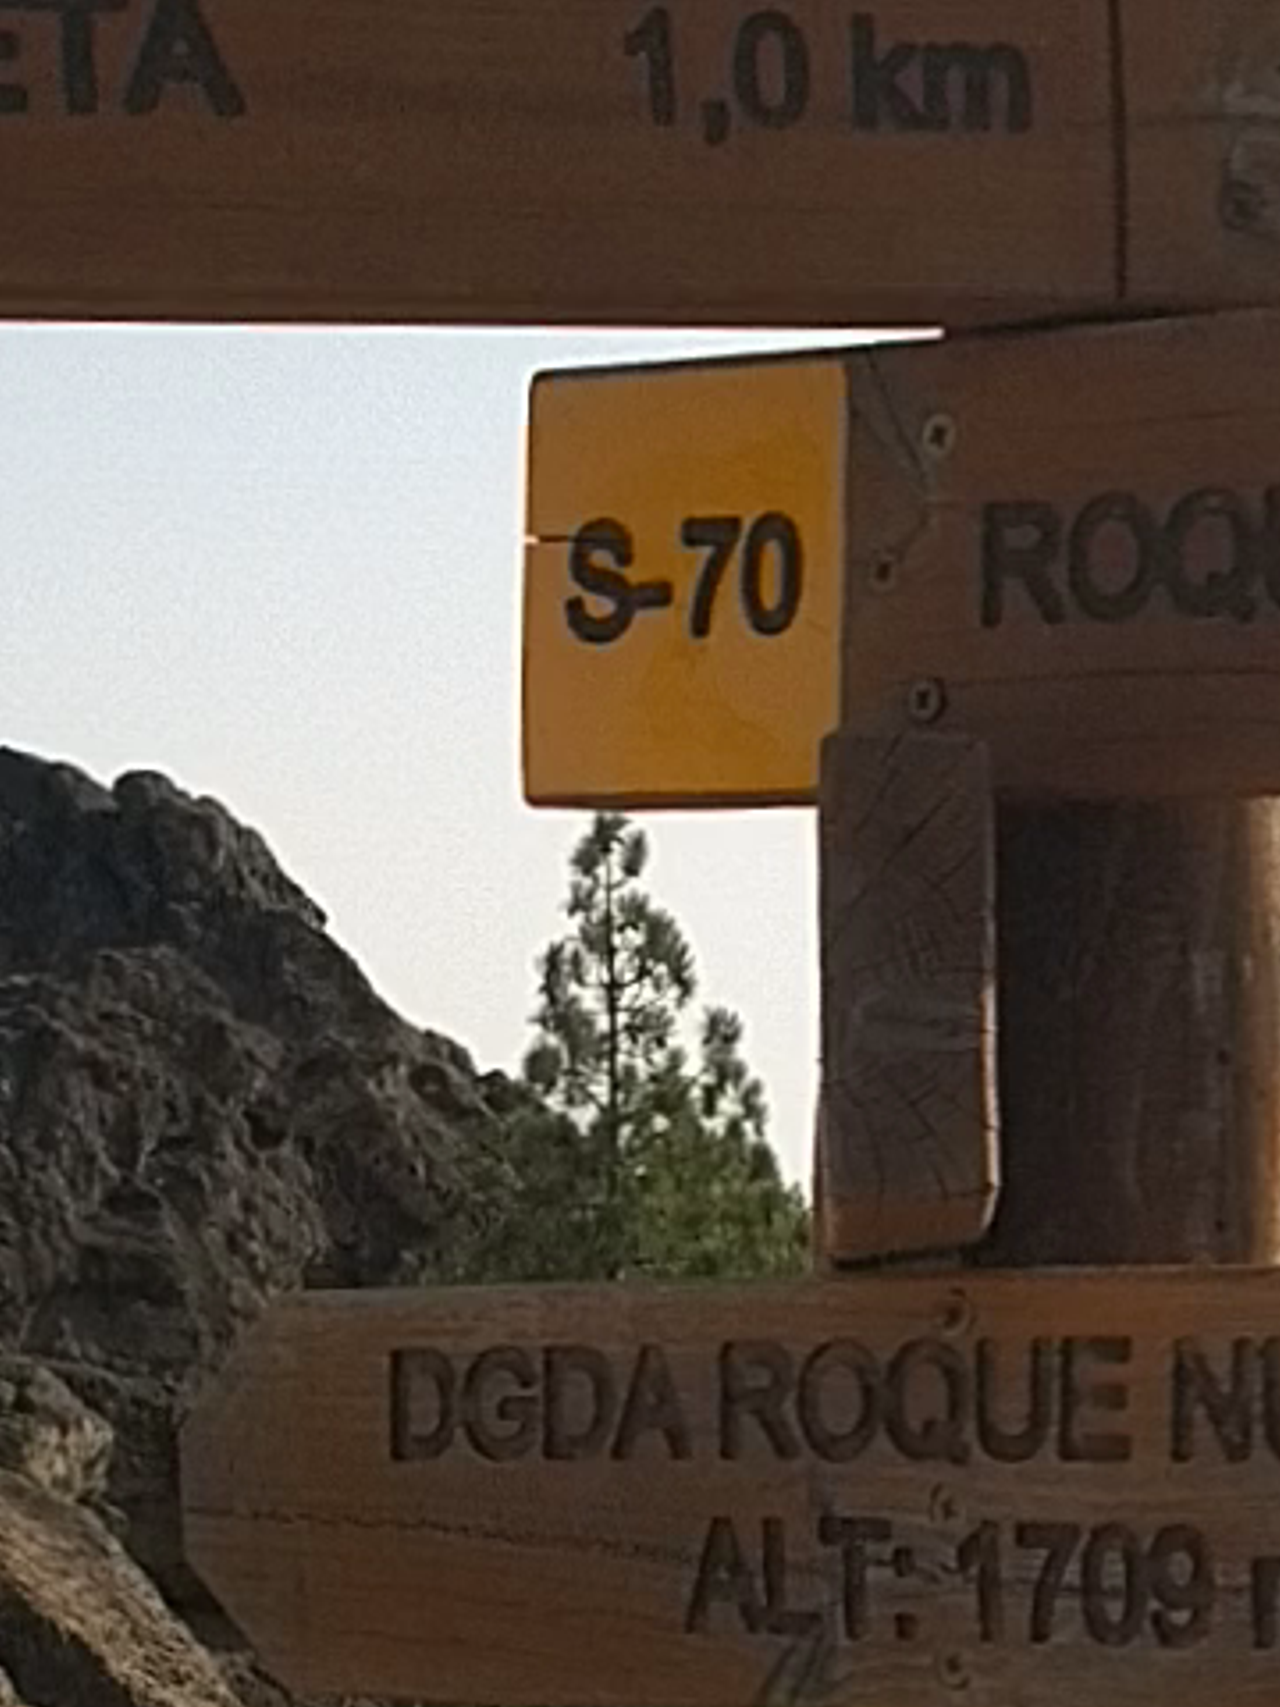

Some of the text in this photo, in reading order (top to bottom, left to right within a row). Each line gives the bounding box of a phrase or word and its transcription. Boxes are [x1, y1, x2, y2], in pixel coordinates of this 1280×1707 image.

[622, 5, 813, 146] 1,0
[851, 10, 1034, 135] km
[565, 509, 804, 645] S-70
[387, 1343, 692, 1464] DGDA
[718, 1334, 1133, 1467] ROQUE
[683, 1515, 918, 1641] ALT:
[954, 1520, 1217, 1649] 1709
